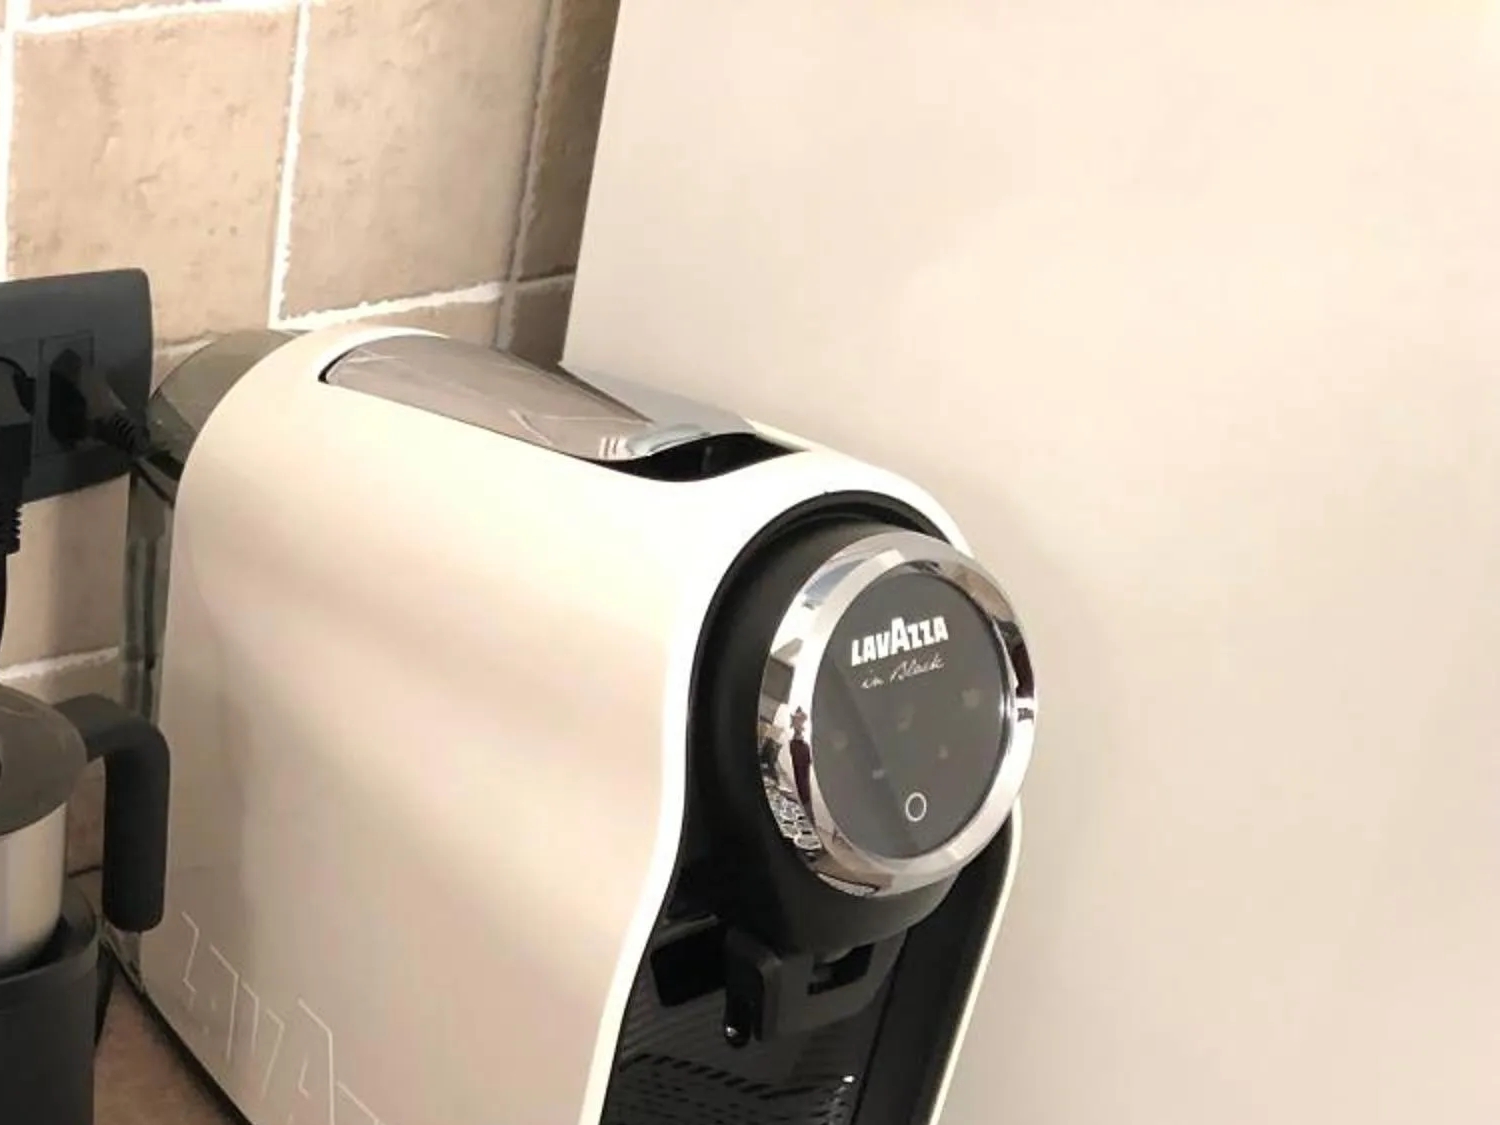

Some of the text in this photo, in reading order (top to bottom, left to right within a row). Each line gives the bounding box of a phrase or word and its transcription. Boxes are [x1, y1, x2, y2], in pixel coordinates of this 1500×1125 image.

[851, 616, 949, 667] LAVAZZA
[860, 652, 945, 689] in Black
